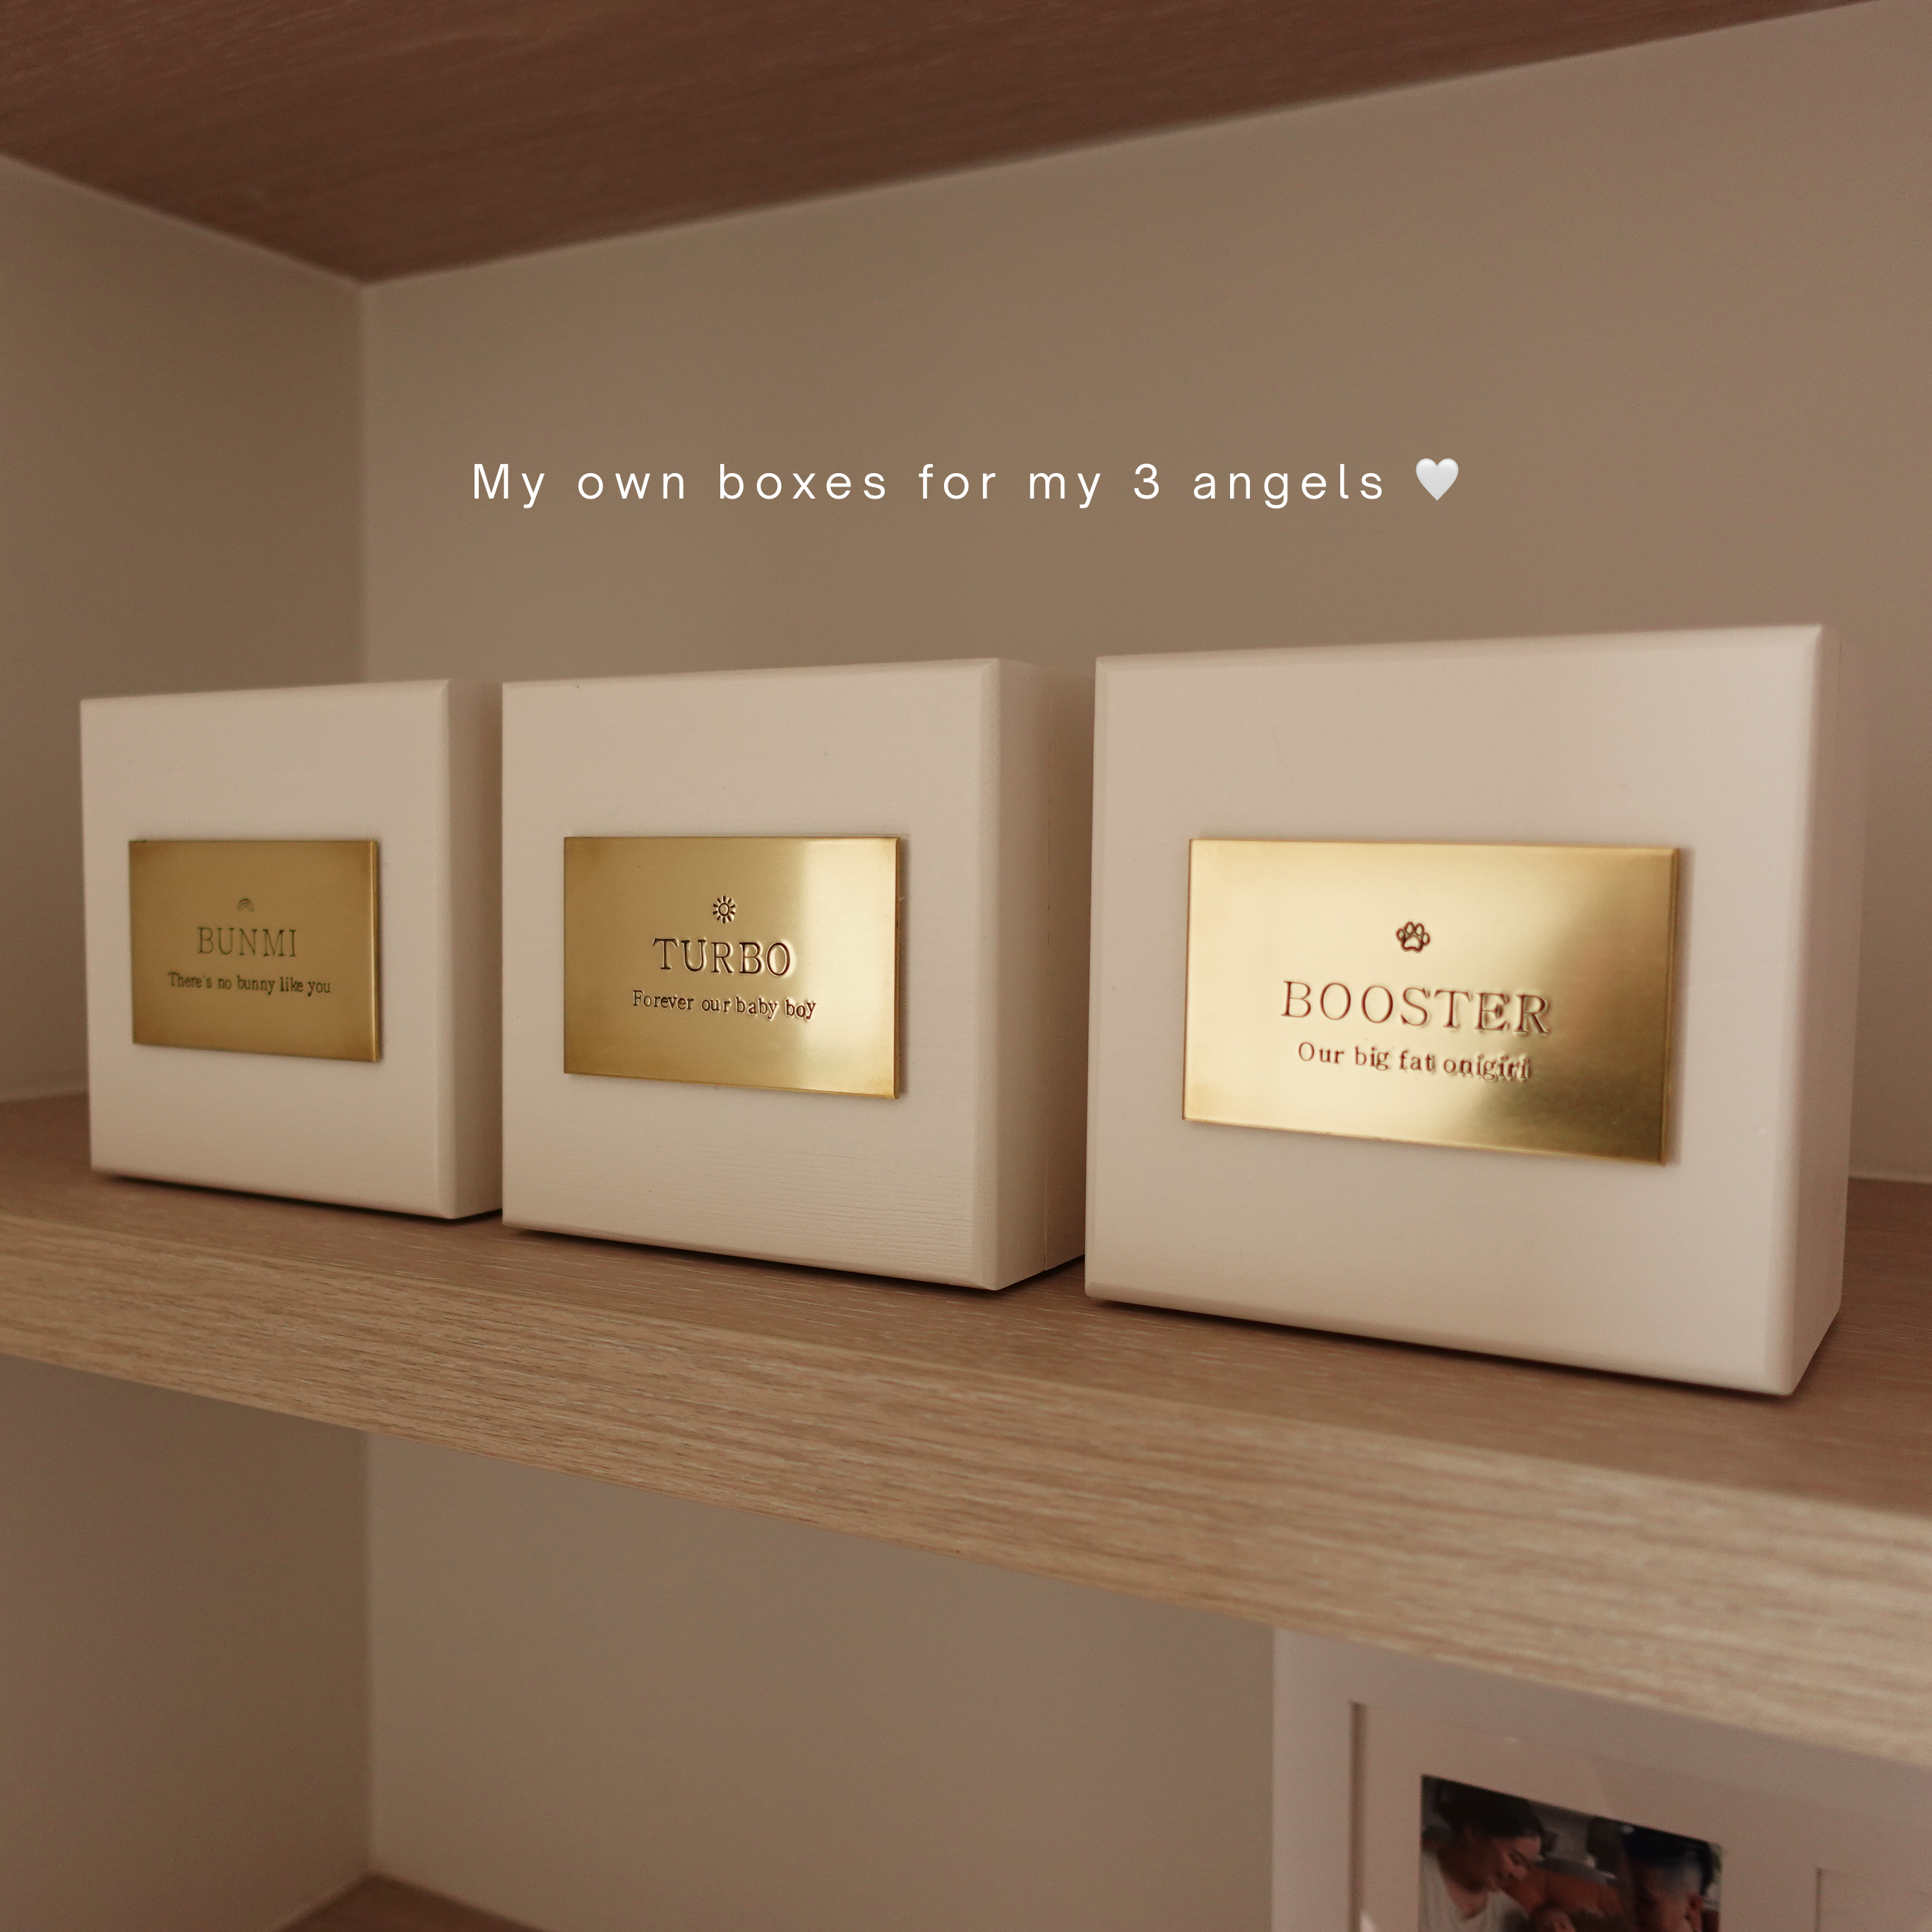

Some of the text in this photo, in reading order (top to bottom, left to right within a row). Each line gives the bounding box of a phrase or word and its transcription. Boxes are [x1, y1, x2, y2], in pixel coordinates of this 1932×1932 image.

[197, 926, 297, 957] BUNMI
[652, 938, 792, 977] TURBO
[167, 971, 330, 997] There's no bunny like you
[633, 990, 816, 1020] Forever our baby boy
[1280, 980, 1550, 1034] BOOSTER
[1298, 1042, 1532, 1081] Our big fat onigiri
